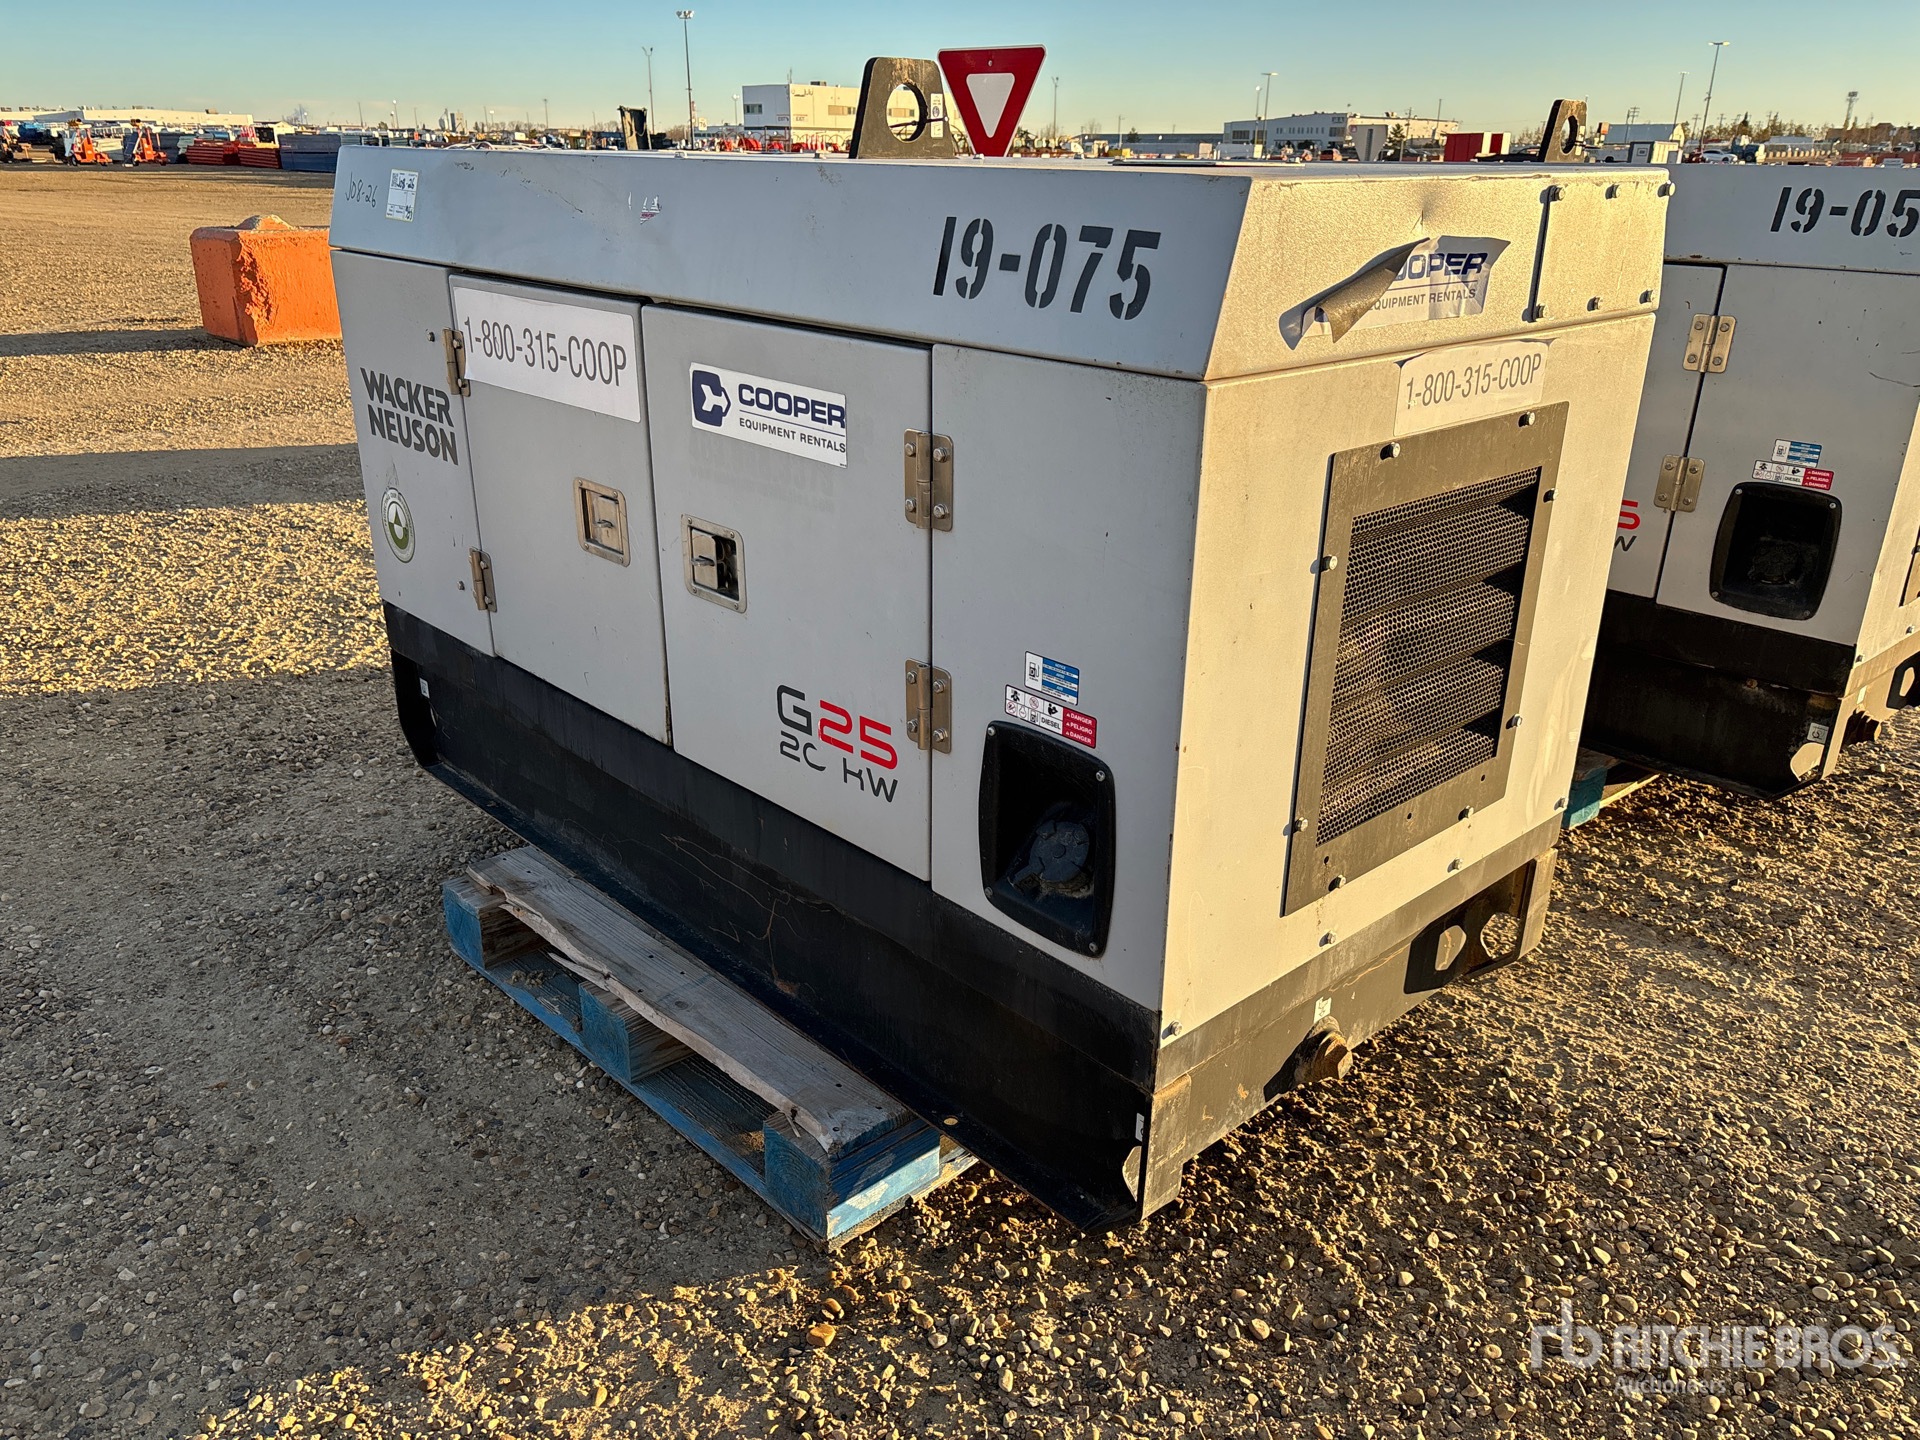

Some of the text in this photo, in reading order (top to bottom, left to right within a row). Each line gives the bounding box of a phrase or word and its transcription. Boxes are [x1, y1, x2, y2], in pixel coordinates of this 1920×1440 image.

[932, 216, 1162, 321] 19-075
[1429, 288, 1477, 304] RENTALS
[464, 316, 627, 387] 1-800-315-COOP
[360, 367, 455, 428] WACKER
[1406, 352, 1542, 410] 1-800-315-COOP
[738, 383, 846, 429] COOPER
[368, 404, 459, 466] NEUSON
[739, 417, 846, 453] EQUIPMENT RENTALS
[776, 684, 899, 771] G25
[1041, 717, 1062, 730] DIESEL
[1069, 731, 1092, 744] DANGER
[1070, 713, 1093, 725] DANGER
[1070, 722, 1093, 735] PELIGRO
